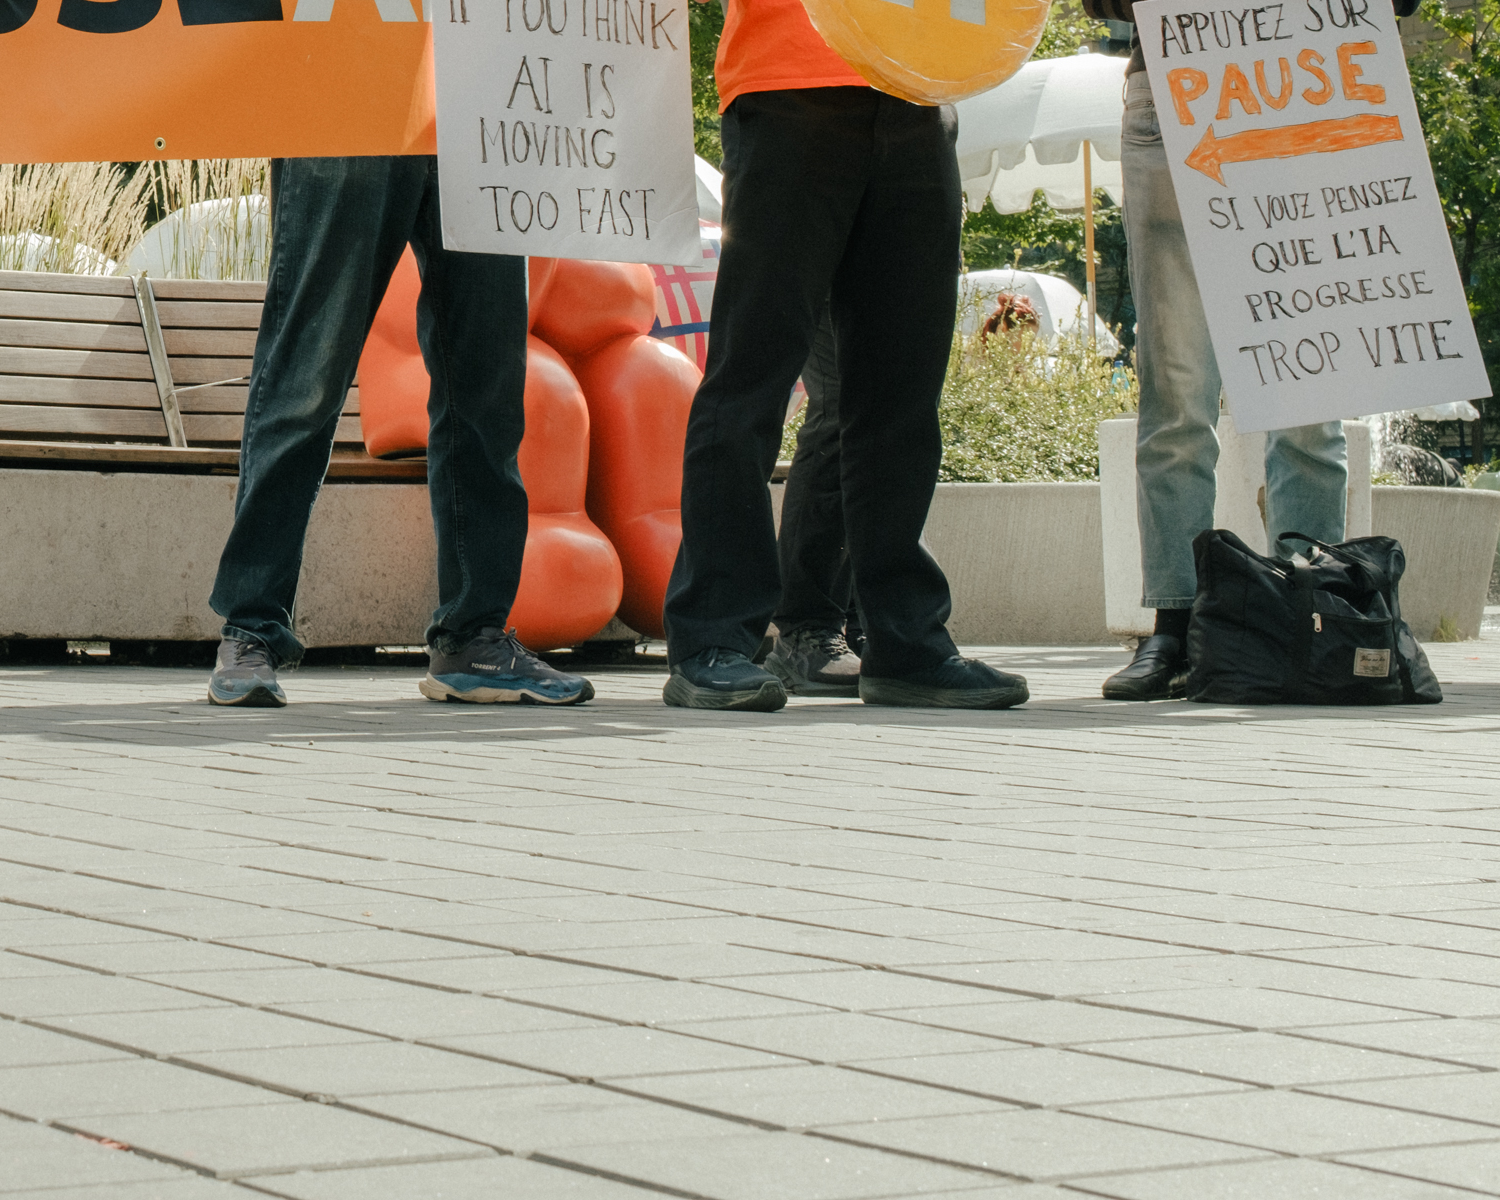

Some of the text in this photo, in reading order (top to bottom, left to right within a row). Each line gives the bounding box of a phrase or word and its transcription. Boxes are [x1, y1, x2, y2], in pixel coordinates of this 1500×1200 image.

[1161, 3, 1293, 58] APPUYEZ
[506, 55, 615, 120] AI IS
[1166, 40, 1387, 126] PAUSE
[480, 116, 616, 170] MOVING
[480, 185, 656, 240] TOO FAST
[1208, 196, 1244, 231] SI
[1320, 176, 1418, 218] PENSEZ
[1252, 224, 1401, 274] QUE L'IA
[1245, 270, 1434, 323] PROGRESSE
[1239, 319, 1464, 386] TROP VITE
